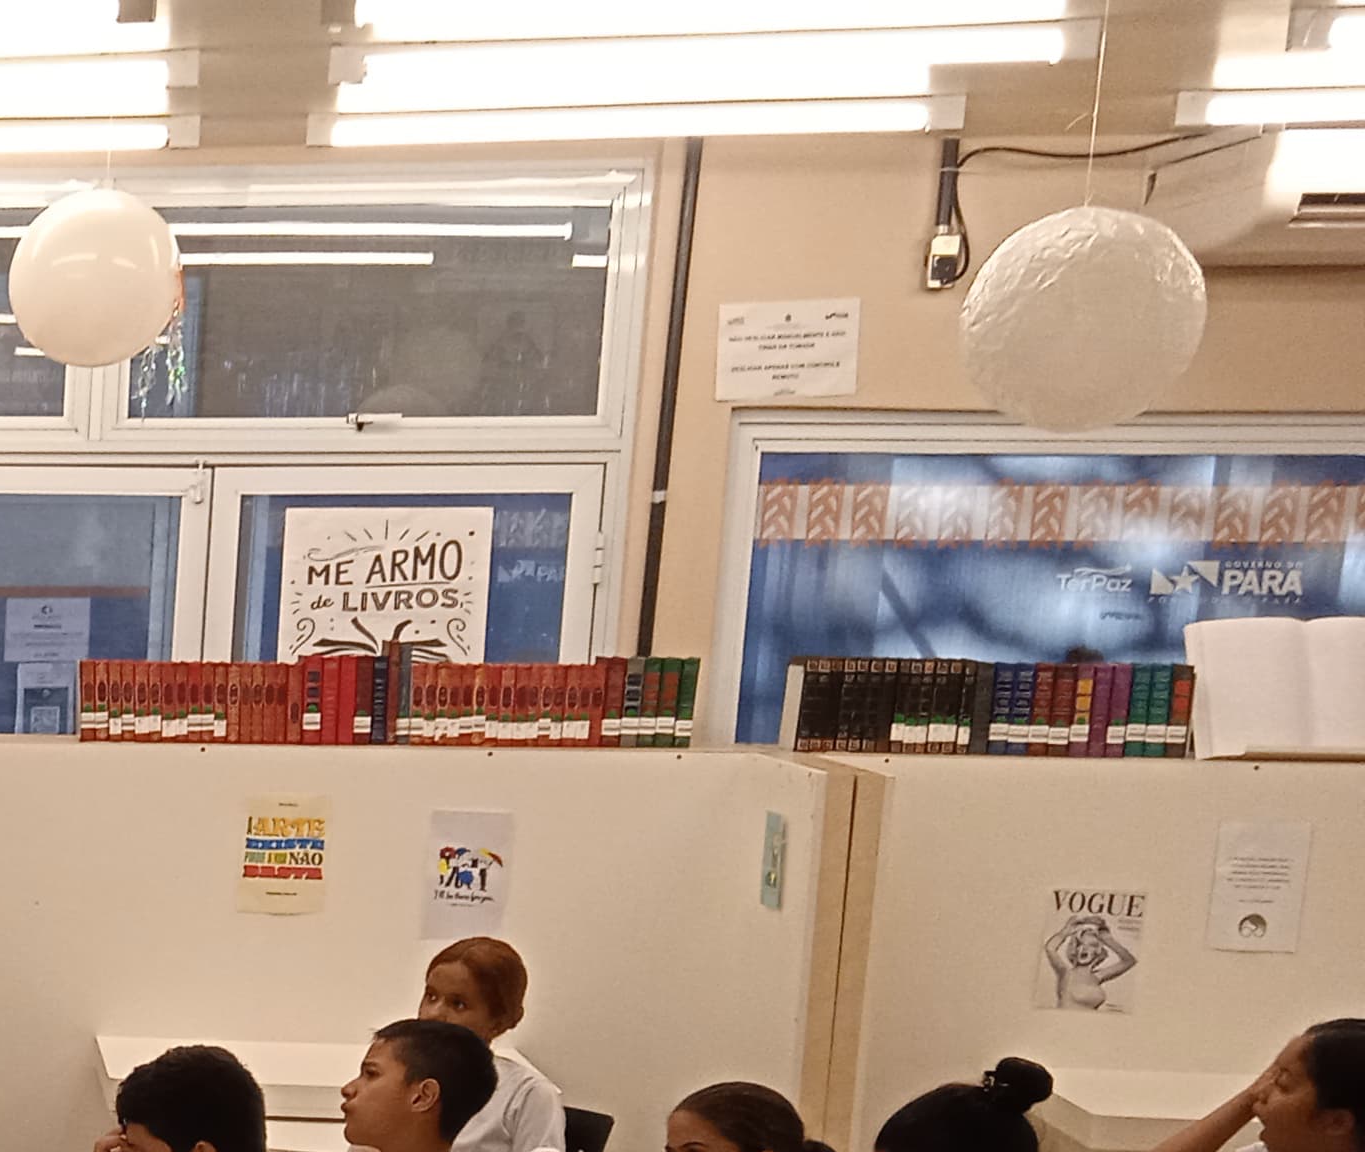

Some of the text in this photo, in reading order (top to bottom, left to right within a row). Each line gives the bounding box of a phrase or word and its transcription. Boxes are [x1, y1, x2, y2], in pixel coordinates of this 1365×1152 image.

[307, 539, 463, 586] ME ARMO
[1057, 573, 1133, 593] TerPaz
[310, 594, 335, 611] de
[1052, 889, 1146, 919] VOGUE
